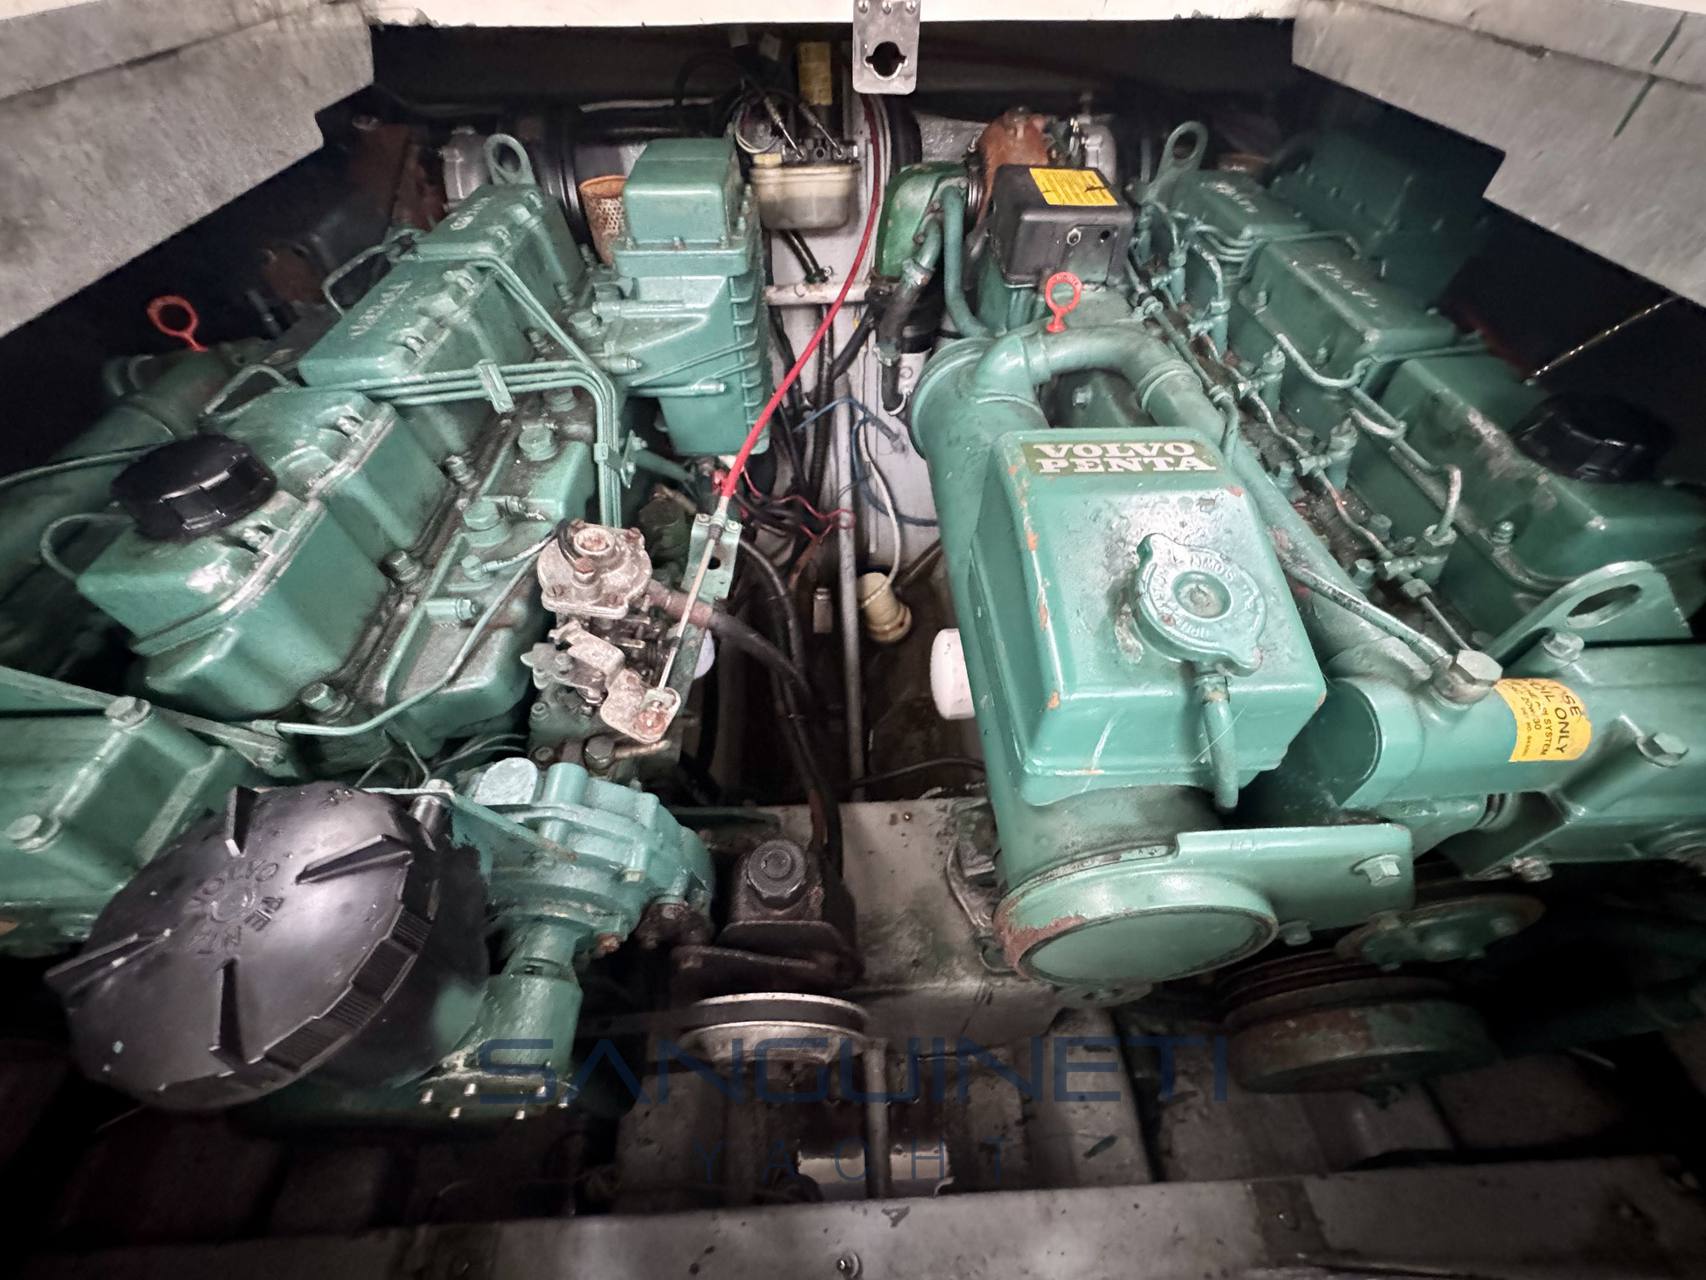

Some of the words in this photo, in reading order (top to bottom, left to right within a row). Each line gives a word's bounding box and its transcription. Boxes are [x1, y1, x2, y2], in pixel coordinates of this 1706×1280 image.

[1033, 442, 1194, 458] VOLVO
[1036, 457, 1216, 473] PENTA
[1540, 718, 1553, 756] SYSTEM
[1555, 708, 1570, 754] ONLY
